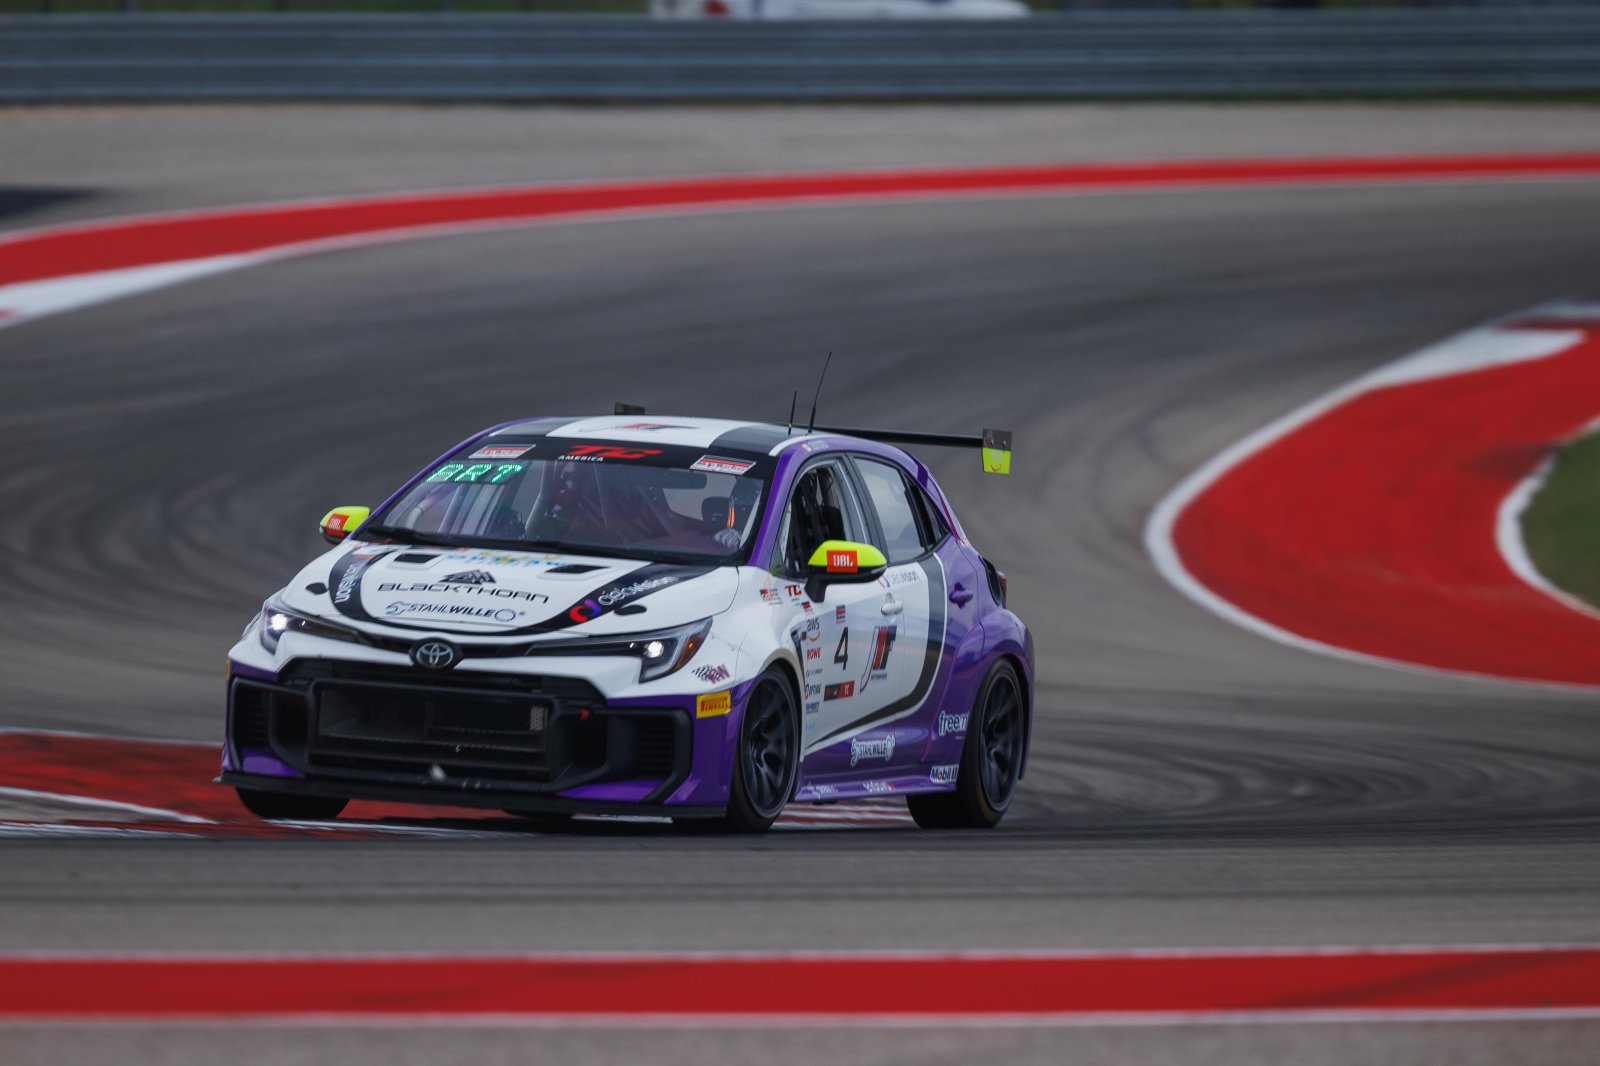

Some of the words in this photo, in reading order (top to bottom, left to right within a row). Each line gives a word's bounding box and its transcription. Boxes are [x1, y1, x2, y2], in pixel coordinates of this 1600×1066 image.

[832, 554, 853, 567] JBL
[377, 582, 549, 604] BLACKTHORN
[409, 602, 493, 618] STAHLWILLE
[833, 626, 849, 671] 4
